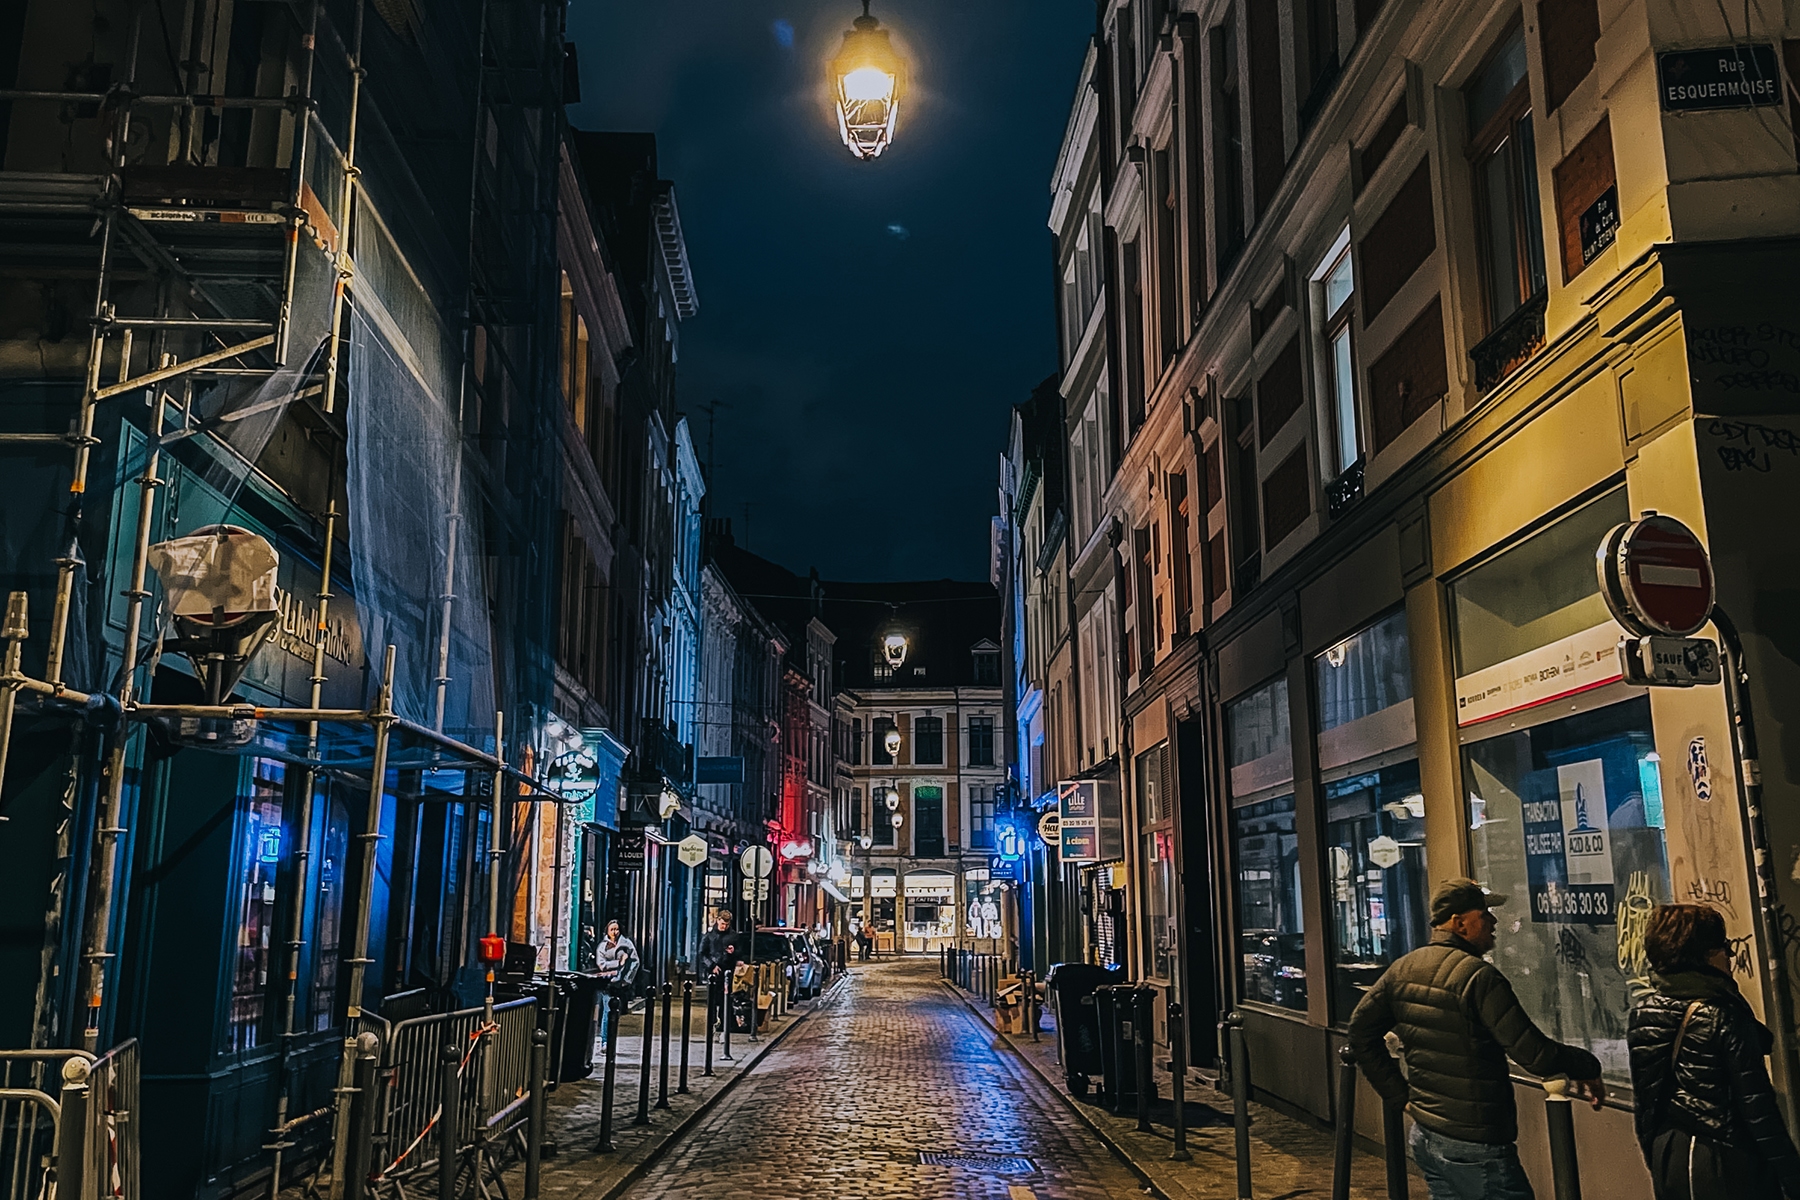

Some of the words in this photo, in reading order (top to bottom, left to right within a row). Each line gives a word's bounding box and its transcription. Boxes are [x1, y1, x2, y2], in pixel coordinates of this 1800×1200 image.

[1718, 58, 1746, 73] Rue
[1668, 79, 1775, 101] ESQUERMOISE
[1655, 651, 1683, 667] SAUF
[1068, 789, 1086, 806] LILLE
[1523, 800, 1560, 823] TRANSACTION
[1551, 832, 1563, 855] PAR
[1585, 836, 1592, 852] &
[1593, 835, 1604, 852] CO
[1537, 892, 1550, 914] 06
[1564, 892, 1578, 915] 36
[1578, 892, 1592, 915] 30
[1593, 892, 1608, 915] 33
